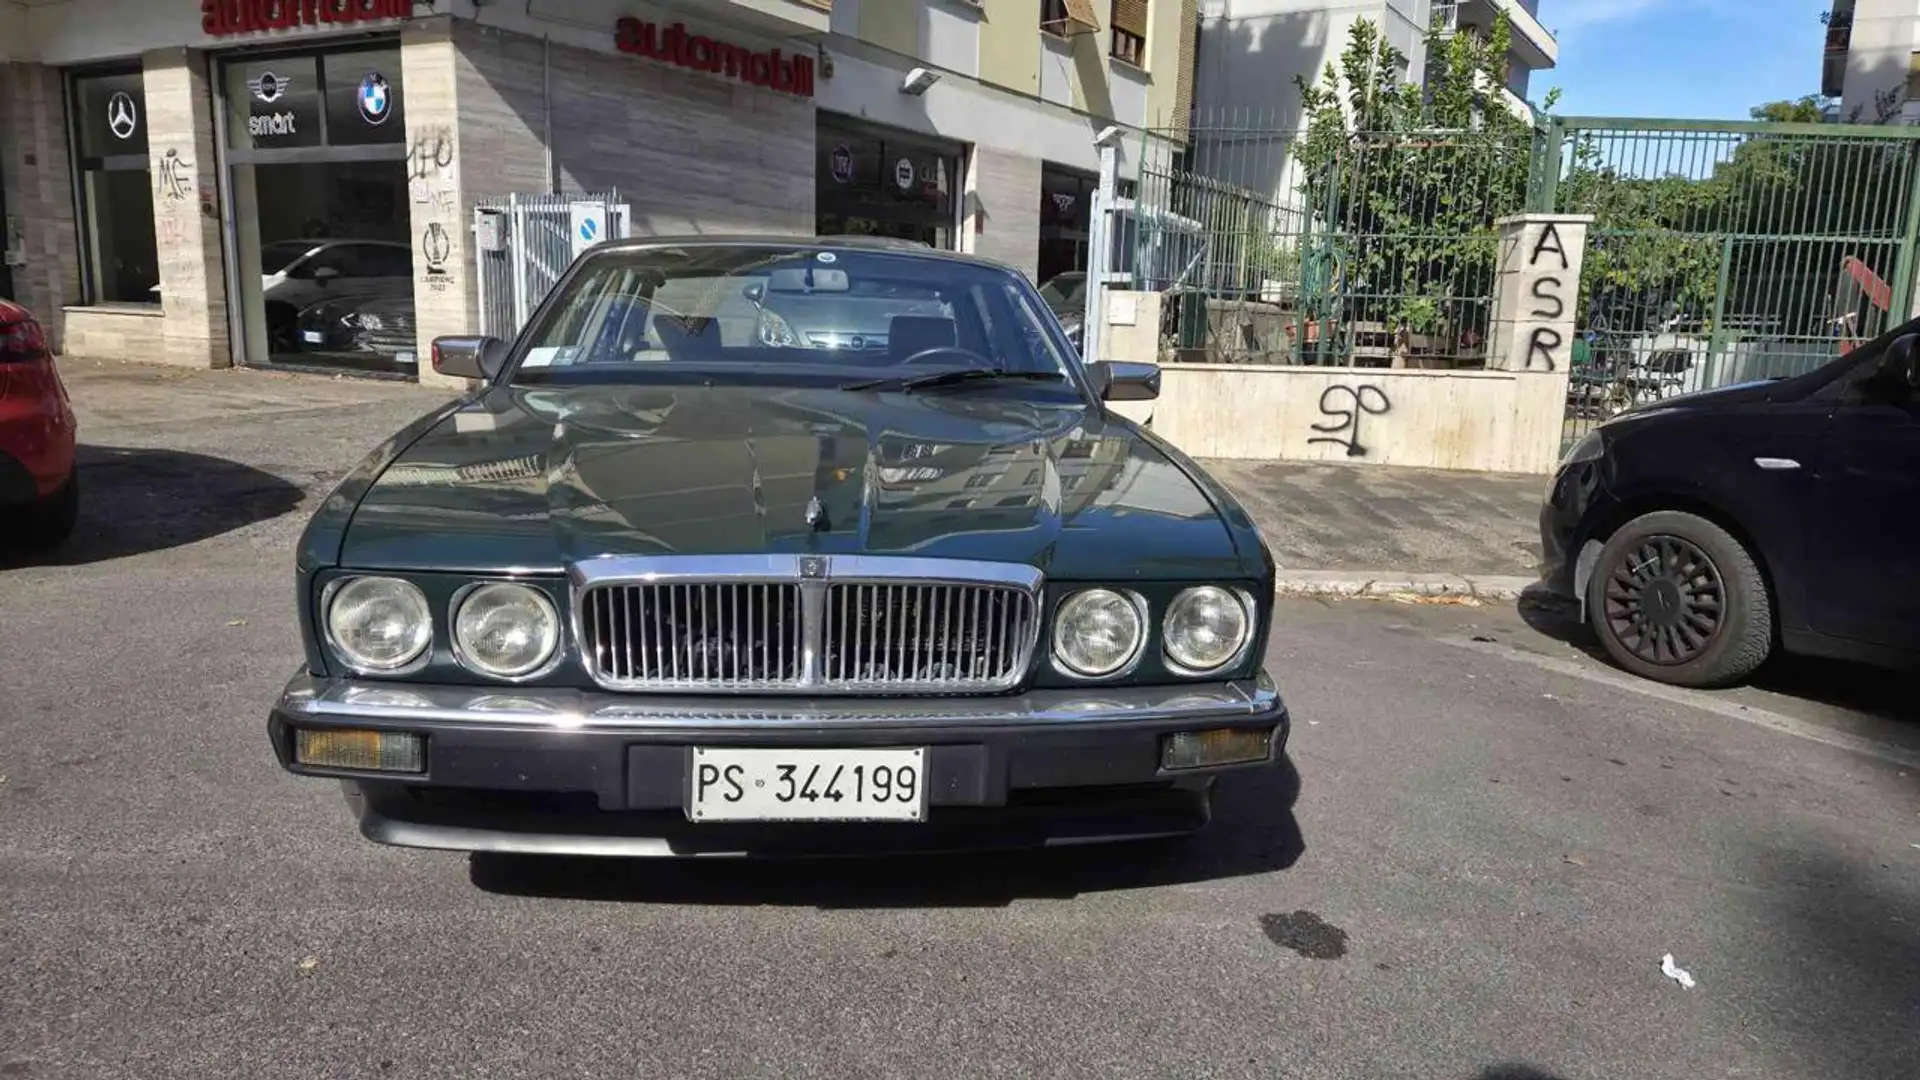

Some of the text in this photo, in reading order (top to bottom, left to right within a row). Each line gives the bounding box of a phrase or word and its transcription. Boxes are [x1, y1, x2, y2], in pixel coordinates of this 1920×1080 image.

[614, 16, 814, 97] automobili
[250, 111, 296, 135] smart
[698, 763, 917, 803] PS 344199
